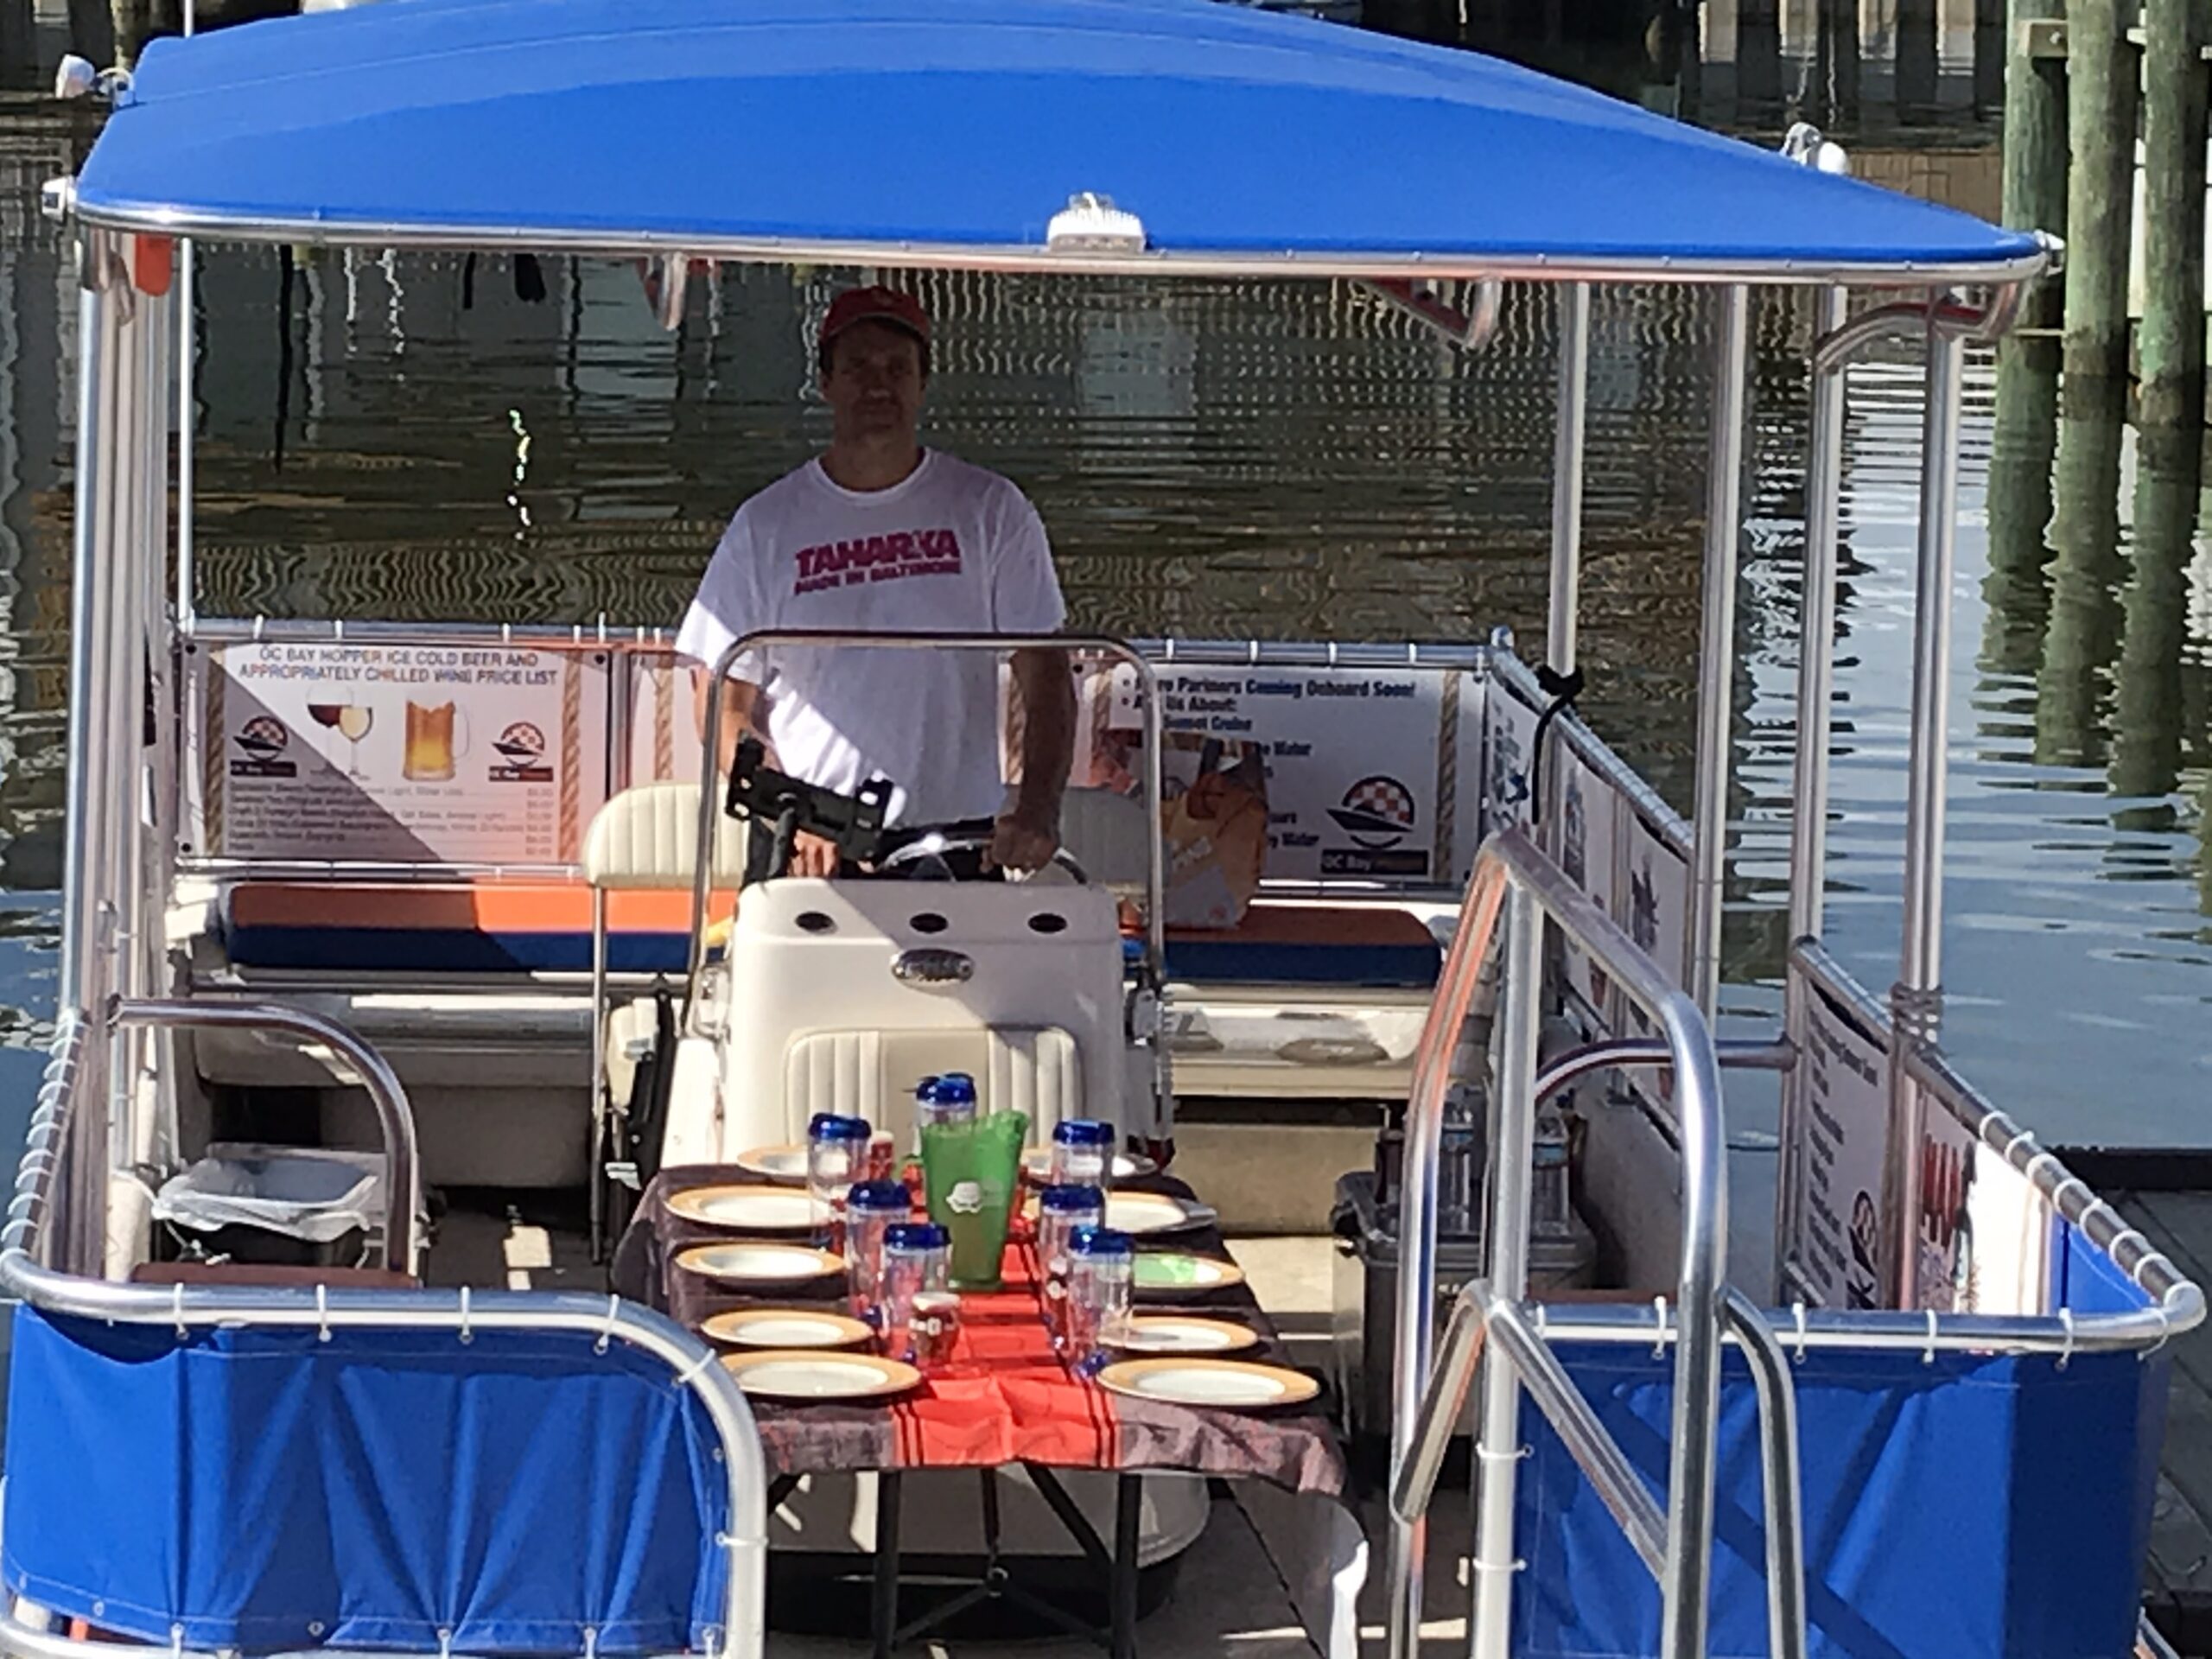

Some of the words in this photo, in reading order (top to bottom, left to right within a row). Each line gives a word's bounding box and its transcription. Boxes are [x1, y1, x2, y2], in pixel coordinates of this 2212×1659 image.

[288, 648, 315, 663] BAY
[321, 650, 381, 664] HOPPER
[387, 650, 411, 664] ICE
[416, 652, 458, 665] COLD
[462, 652, 501, 666] BEER
[506, 652, 538, 666] AND
[239, 664, 361, 681] APPROPRIATELY
[365, 666, 429, 683] CHILLED
[434, 669, 472, 683] WINE
[477, 670, 521, 684] PRICE
[525, 671, 557, 685] LIST
[1178, 677, 1242, 694] Partners
[1246, 679, 1301, 698] Coming
[1306, 679, 1369, 696] Onboard
